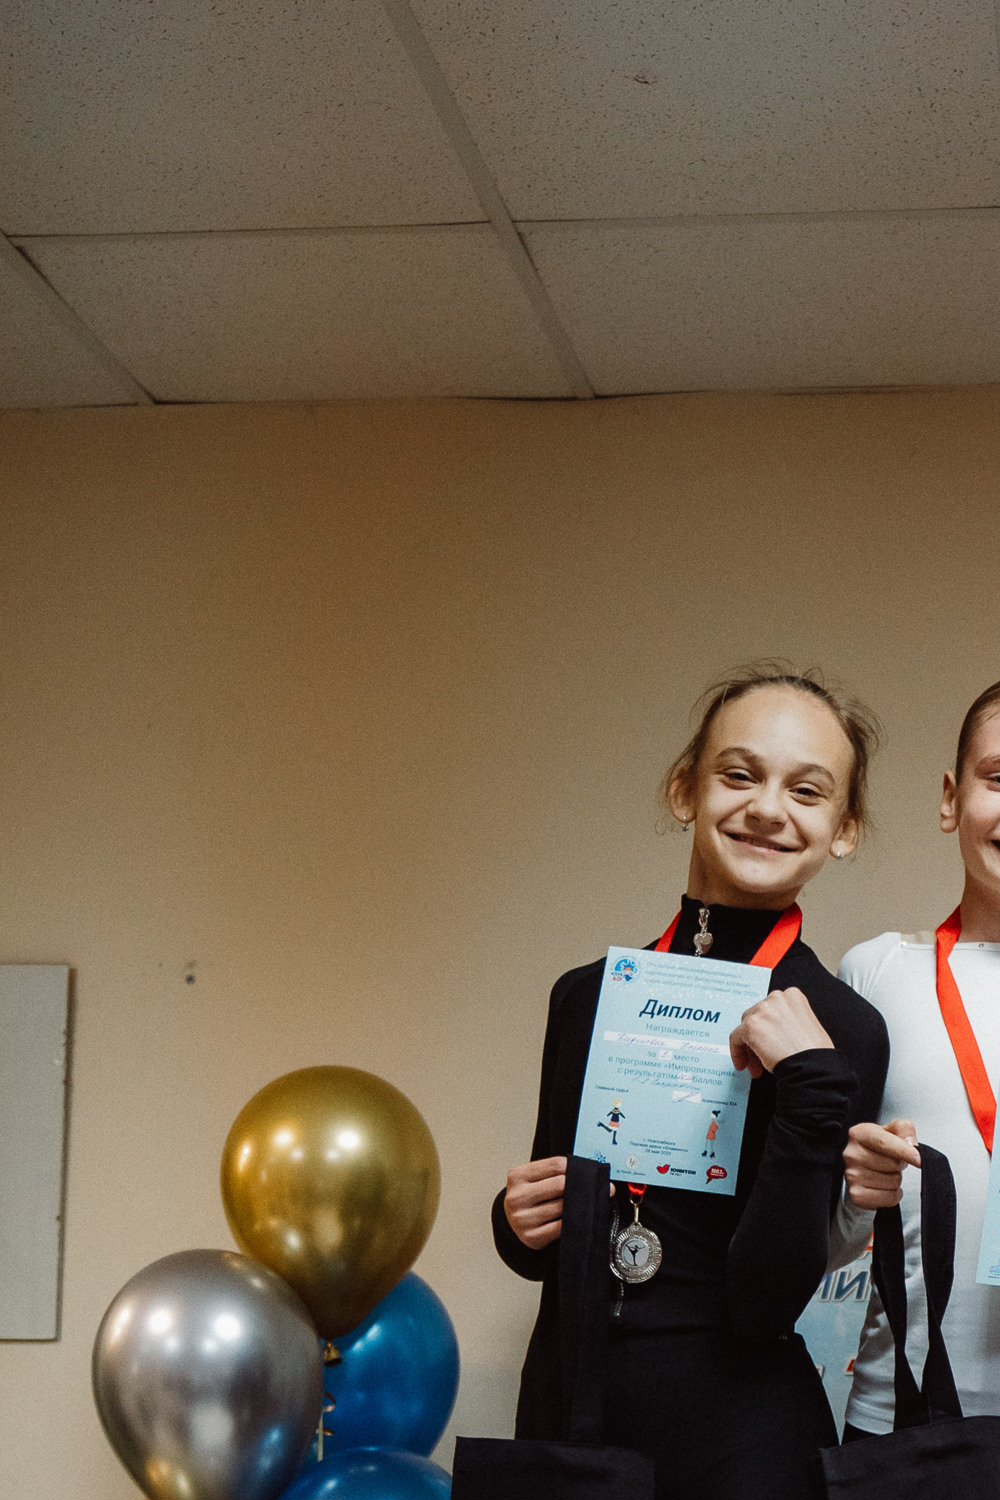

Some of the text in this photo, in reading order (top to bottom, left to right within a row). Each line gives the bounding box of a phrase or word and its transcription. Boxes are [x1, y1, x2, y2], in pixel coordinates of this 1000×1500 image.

[639, 998, 721, 1024] Диплом
[645, 1023, 710, 1039] Награждается
[615, 1057, 662, 1070] программе
[673, 1054, 700, 1064] место
[623, 1068, 678, 1081] результатом
[692, 1075, 723, 1086] баллов
